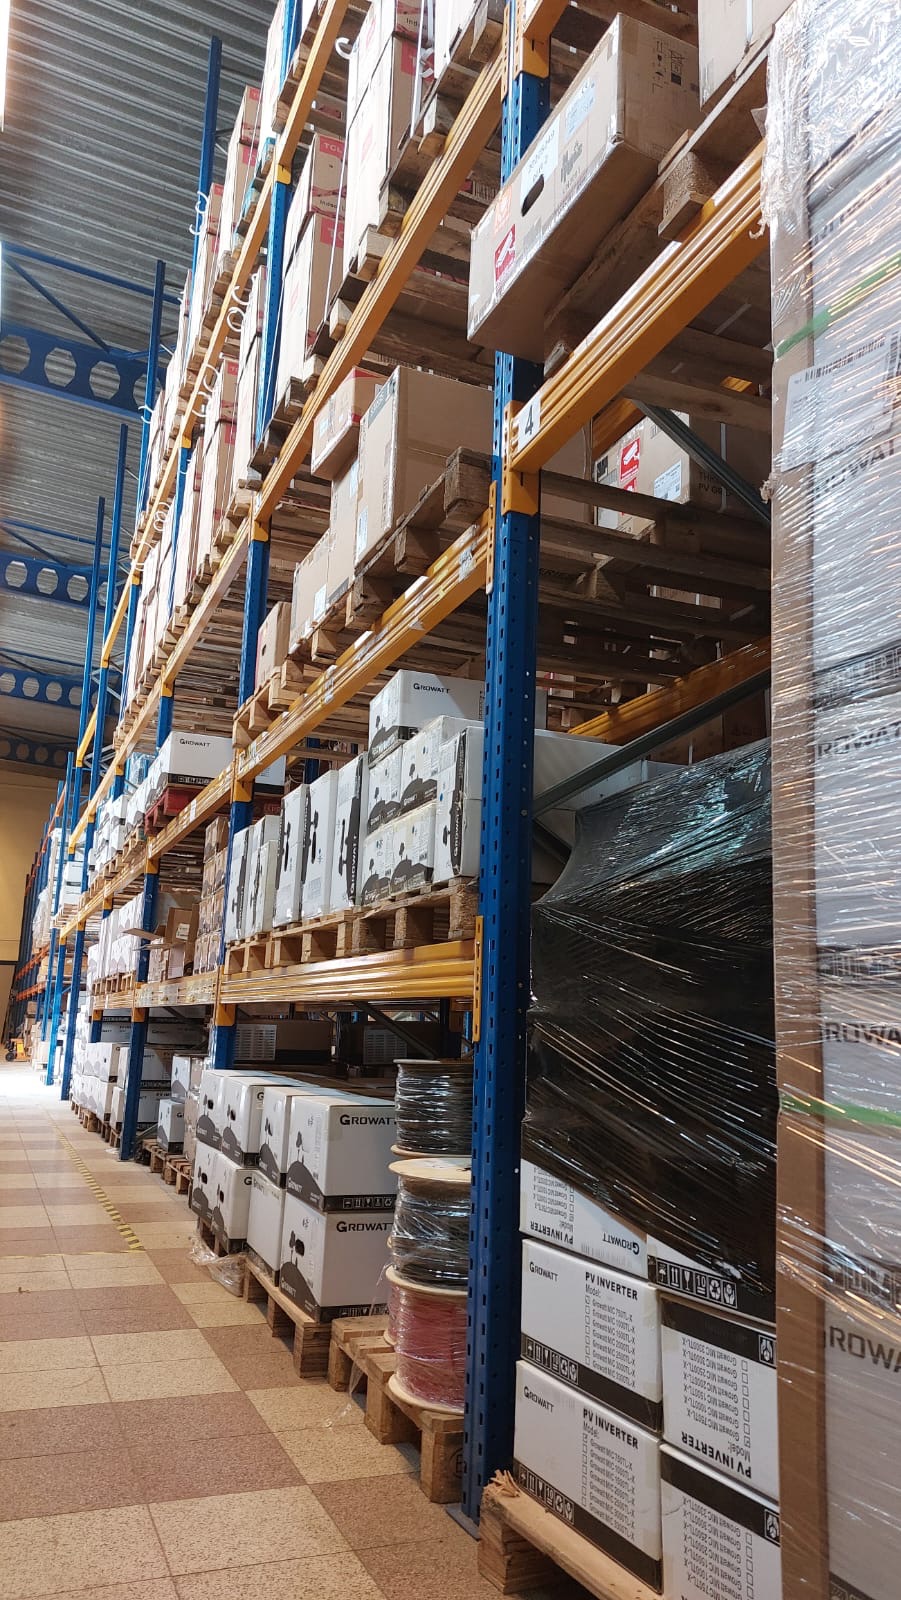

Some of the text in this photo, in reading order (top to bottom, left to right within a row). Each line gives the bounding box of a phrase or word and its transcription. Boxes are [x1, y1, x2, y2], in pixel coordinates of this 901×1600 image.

[324, 142, 342, 153] TCL
[524, 404, 534, 435] 4
[414, 682, 450, 694] GROWATT
[180, 738, 211, 747] GROWATT
[821, 1022, 901, 1044] ROWA
[530, 1221, 573, 1245] PV INVERTER
[602, 1233, 640, 1255] GROWATT
[530, 1261, 558, 1282] GROWATT
[586, 1272, 638, 1300] PV INVERTER
[586, 1284, 601, 1297] Model:
[716, 1352, 736, 1365] Growatt
[824, 1326, 901, 1373] ROW
[716, 1363, 736, 1378] Growatt
[717, 1375, 737, 1390] Growatt
[524, 1386, 554, 1413] GROWATT
[717, 1387, 738, 1402] Growatt
[717, 1399, 738, 1415] Growatt
[583, 1408, 638, 1449] PV INVERTER
[718, 1411, 738, 1428] Growatt
[718, 1424, 739, 1441] Growatt
[681, 1431, 752, 1478] PV INVERTER
[728, 1441, 750, 1461] Model:
